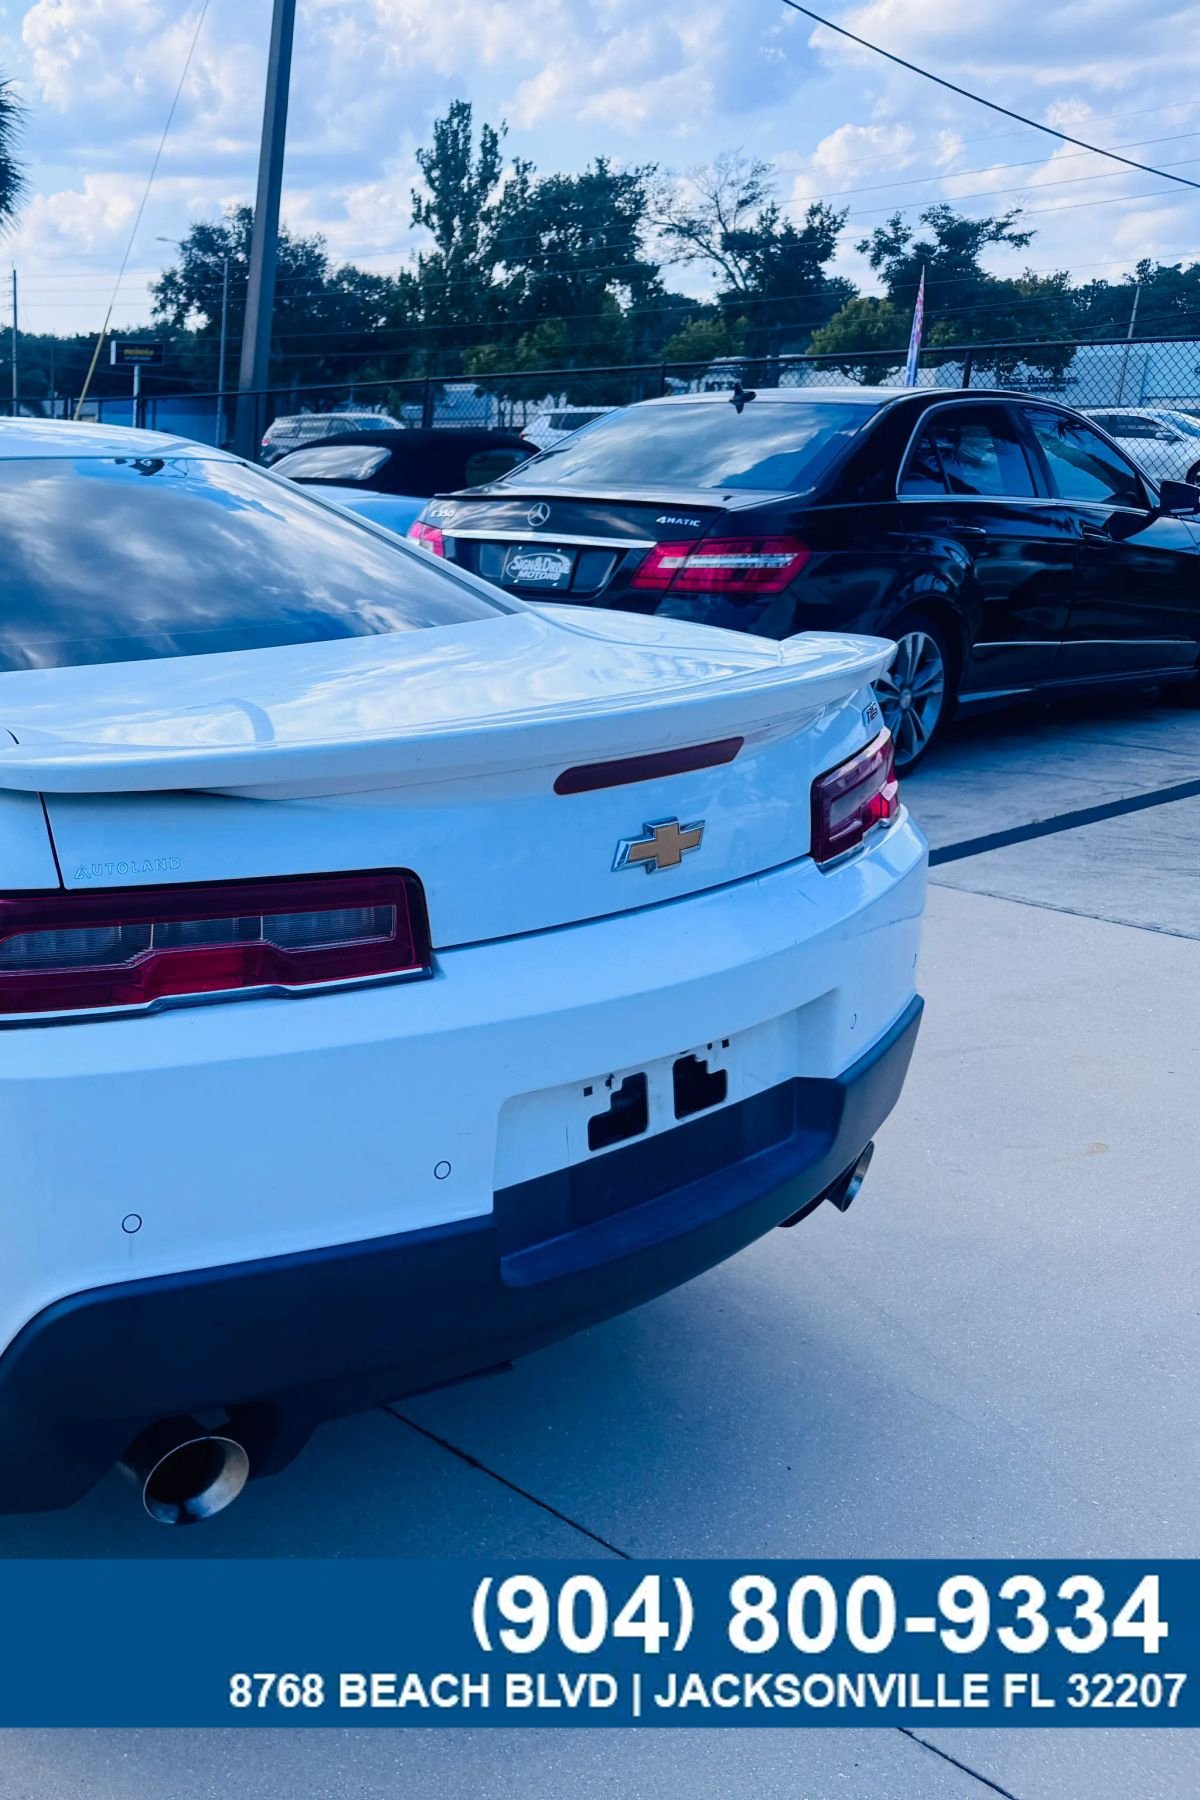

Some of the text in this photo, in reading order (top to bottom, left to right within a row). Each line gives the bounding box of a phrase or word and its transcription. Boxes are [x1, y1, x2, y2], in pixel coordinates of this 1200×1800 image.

[655, 515, 701, 527] 4MATIC
[517, 569, 561, 581] MOTORS
[74, 857, 181, 880] AUTOLAND
